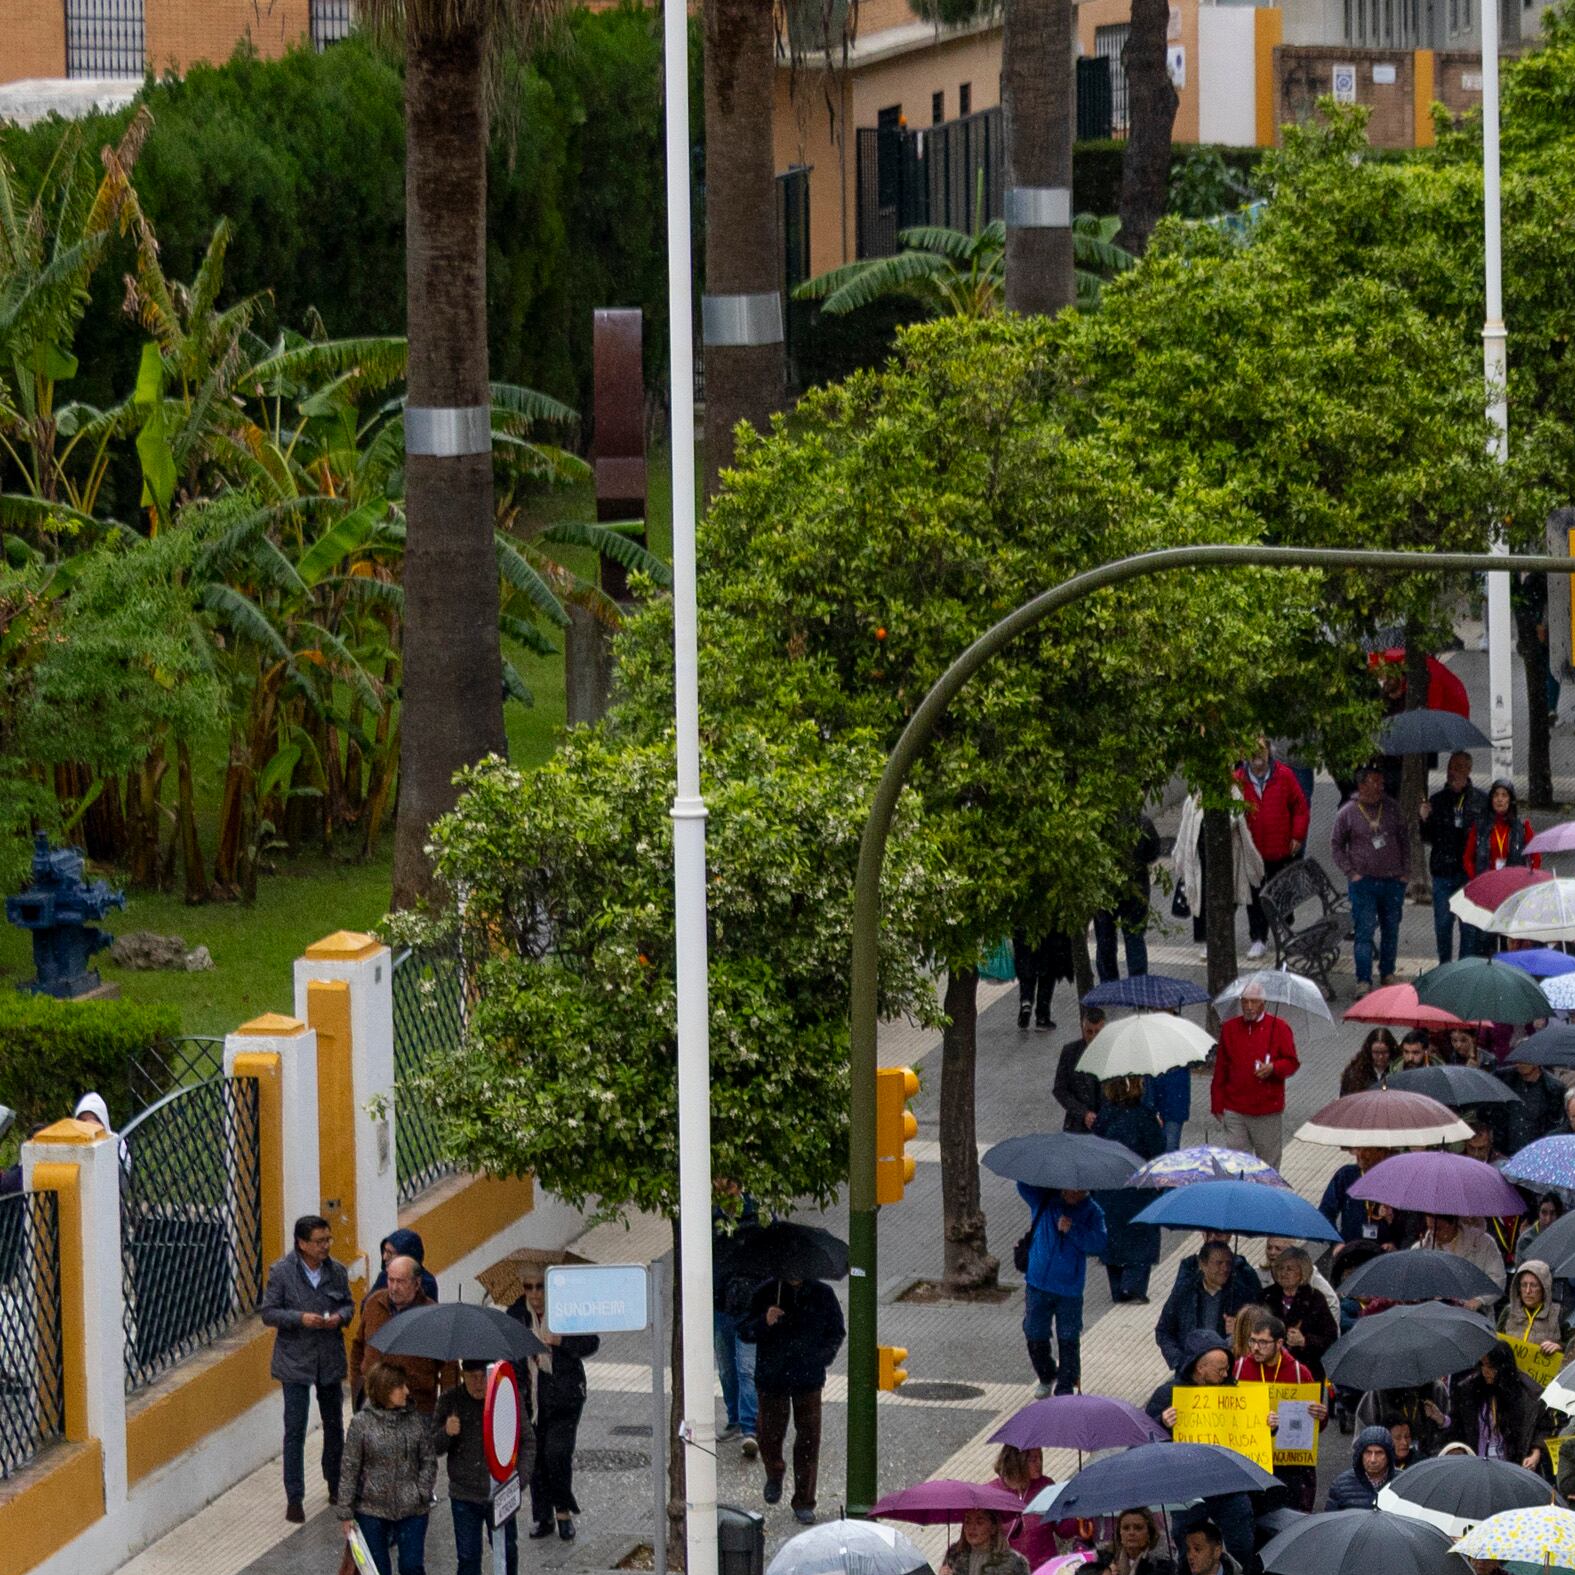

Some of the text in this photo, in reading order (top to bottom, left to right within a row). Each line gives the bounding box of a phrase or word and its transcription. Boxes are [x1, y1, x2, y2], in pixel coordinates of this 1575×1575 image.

[556, 1299, 625, 1317] SUNDHEIM
[1513, 1344, 1552, 1367] NO ES
[1269, 1387, 1298, 1400] ÉNEZ
[1192, 1395, 1248, 1410] 22 HORAS
[1177, 1412, 1263, 1429] JUGANDO A LA
[1229, 1433, 1258, 1447] RUSA
[1274, 1452, 1314, 1464] AQUINISTA
